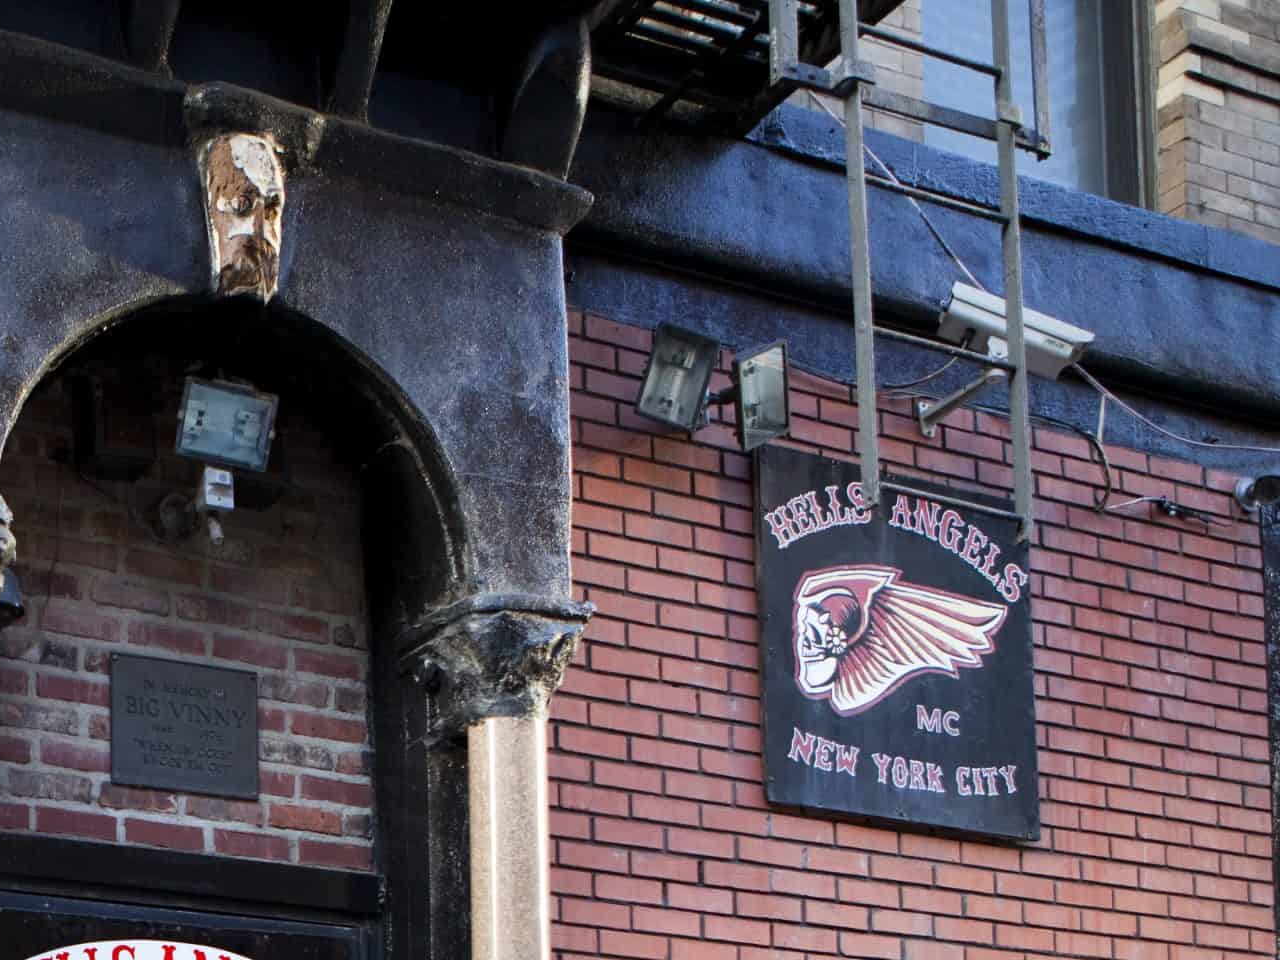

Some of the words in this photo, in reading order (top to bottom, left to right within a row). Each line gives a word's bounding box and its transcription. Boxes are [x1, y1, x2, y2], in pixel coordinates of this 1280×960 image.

[764, 481, 872, 549] HELLS
[888, 494, 1028, 602] ANGELS
[125, 695, 161, 718] BIG
[169, 701, 247, 729] VINNY
[916, 704, 960, 736] MC
[788, 727, 861, 777] NEW
[871, 752, 945, 793] YORK
[956, 764, 1016, 796] CITY
